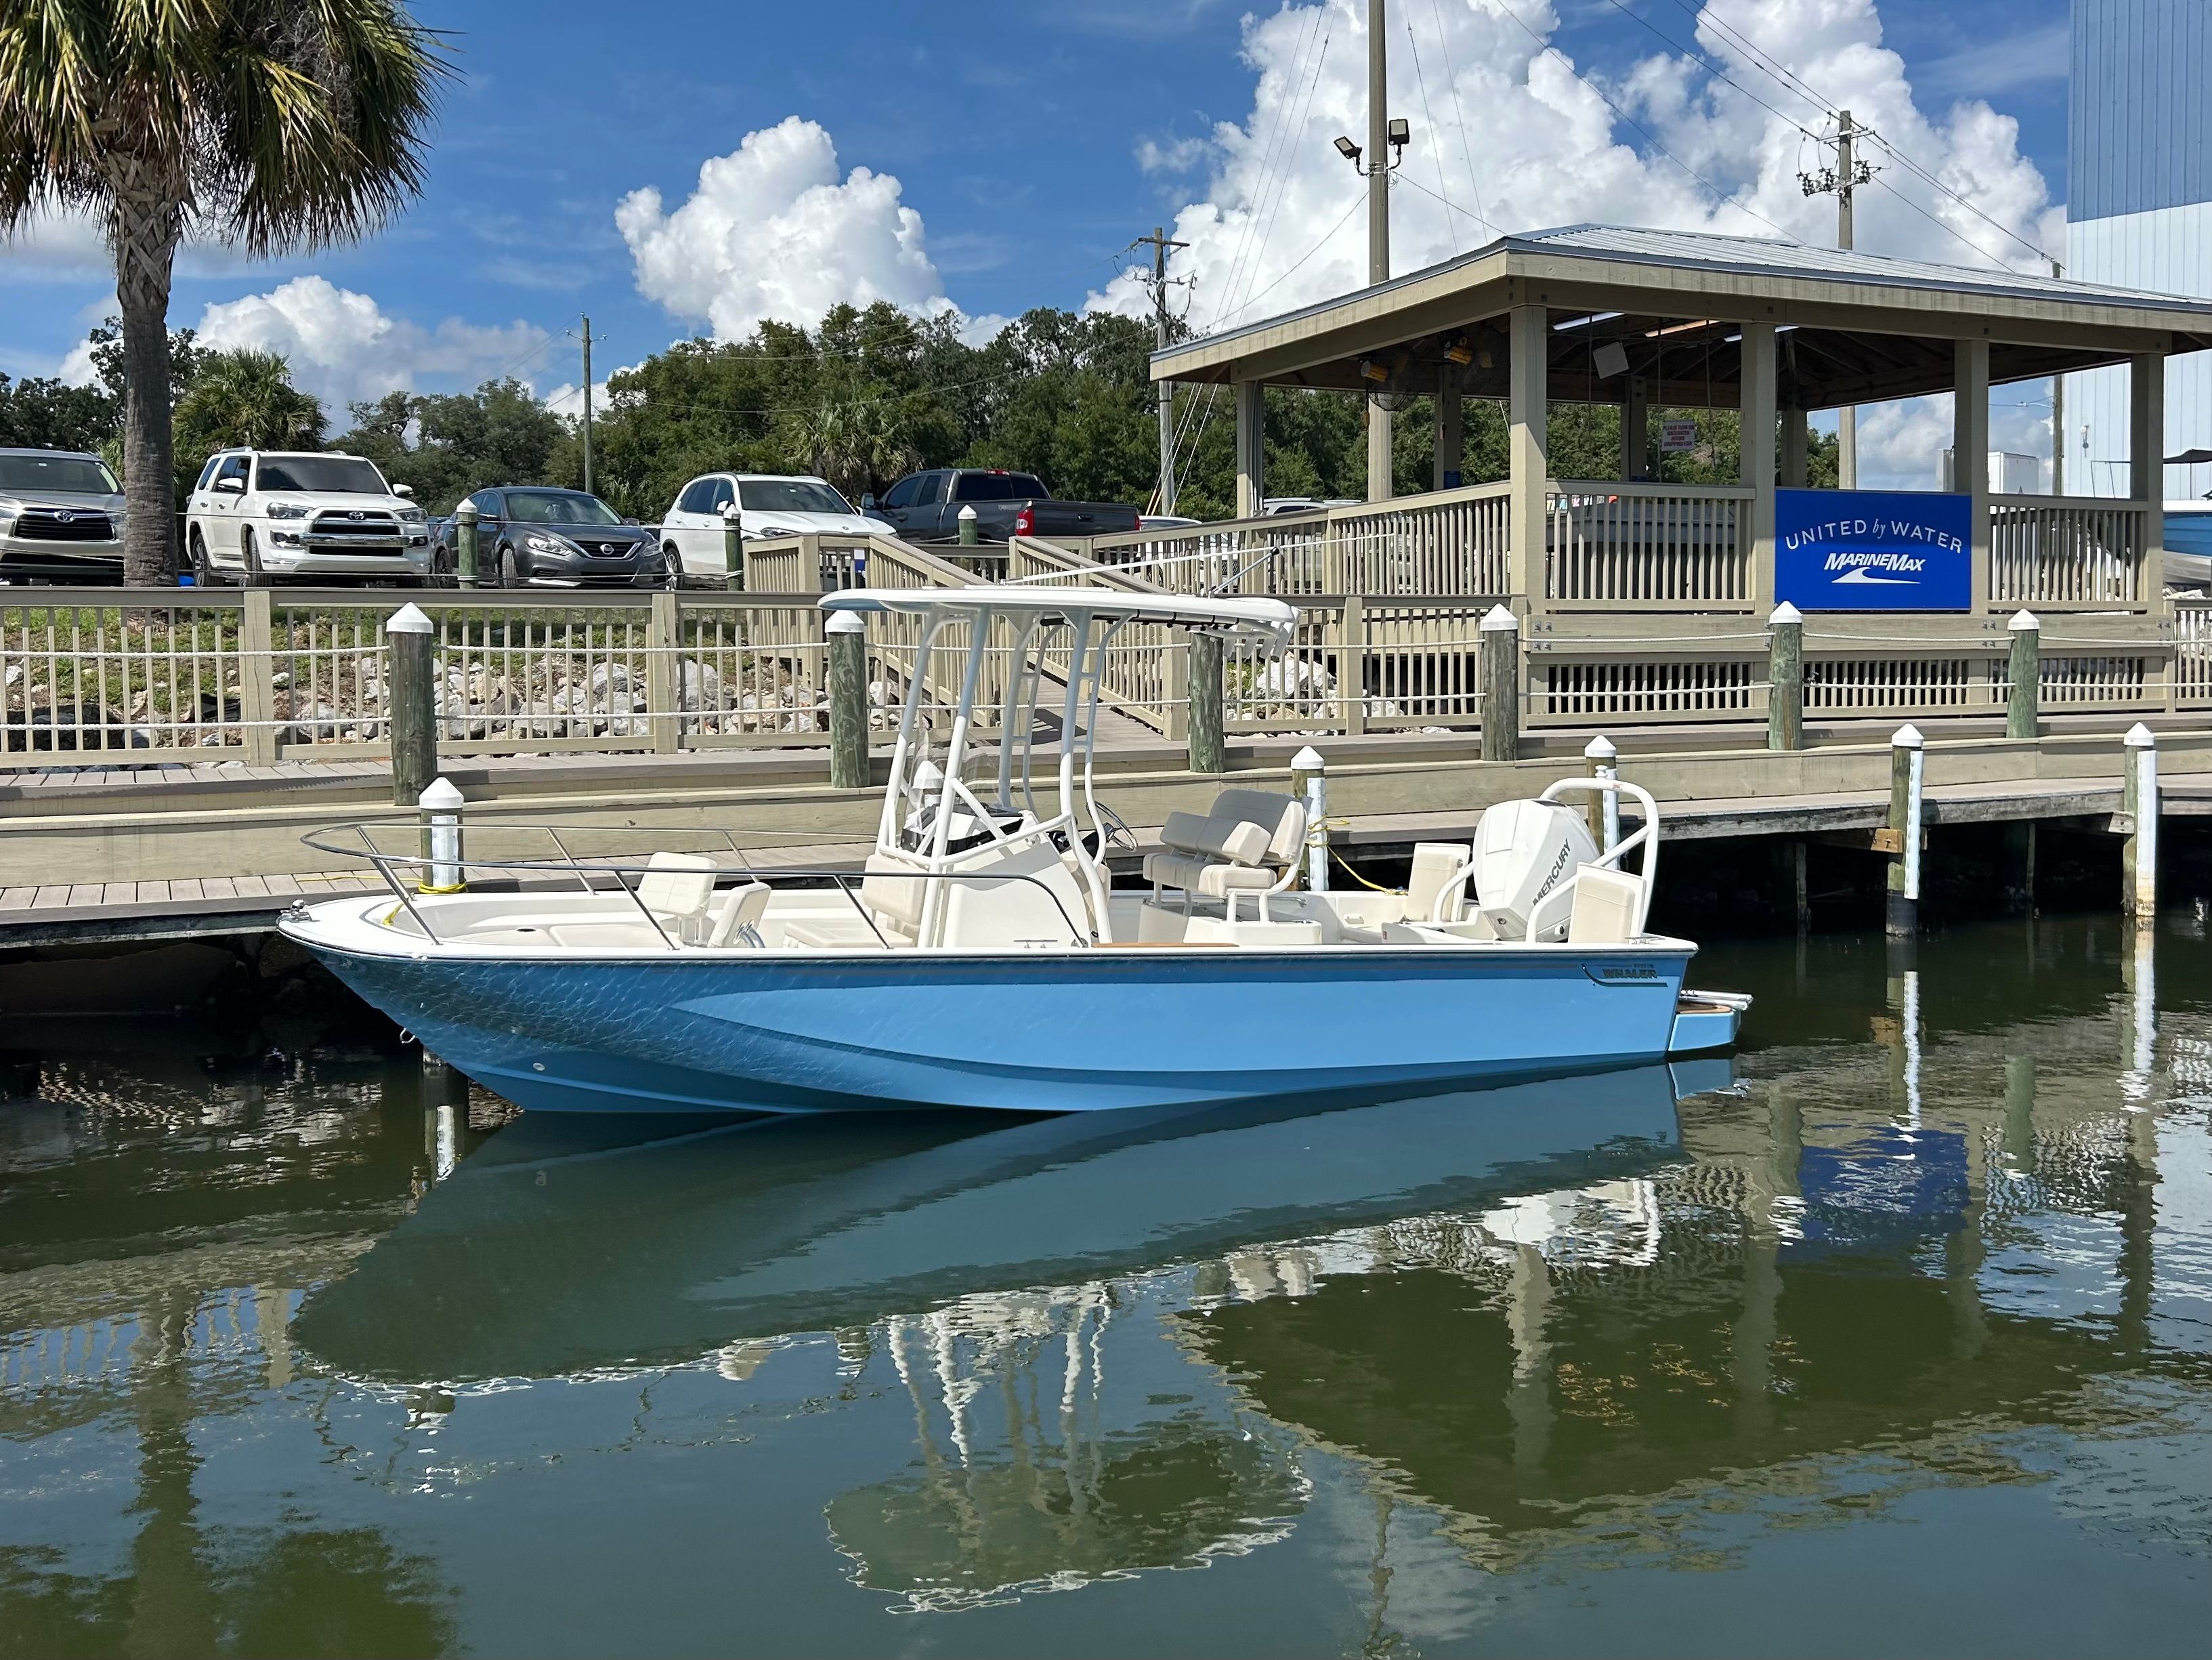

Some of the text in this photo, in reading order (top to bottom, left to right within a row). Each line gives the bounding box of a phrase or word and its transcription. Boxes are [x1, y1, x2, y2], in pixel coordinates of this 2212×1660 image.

[1785, 518, 1962, 553] UNITED by WATER
[1533, 837, 1571, 906] MERCURY
